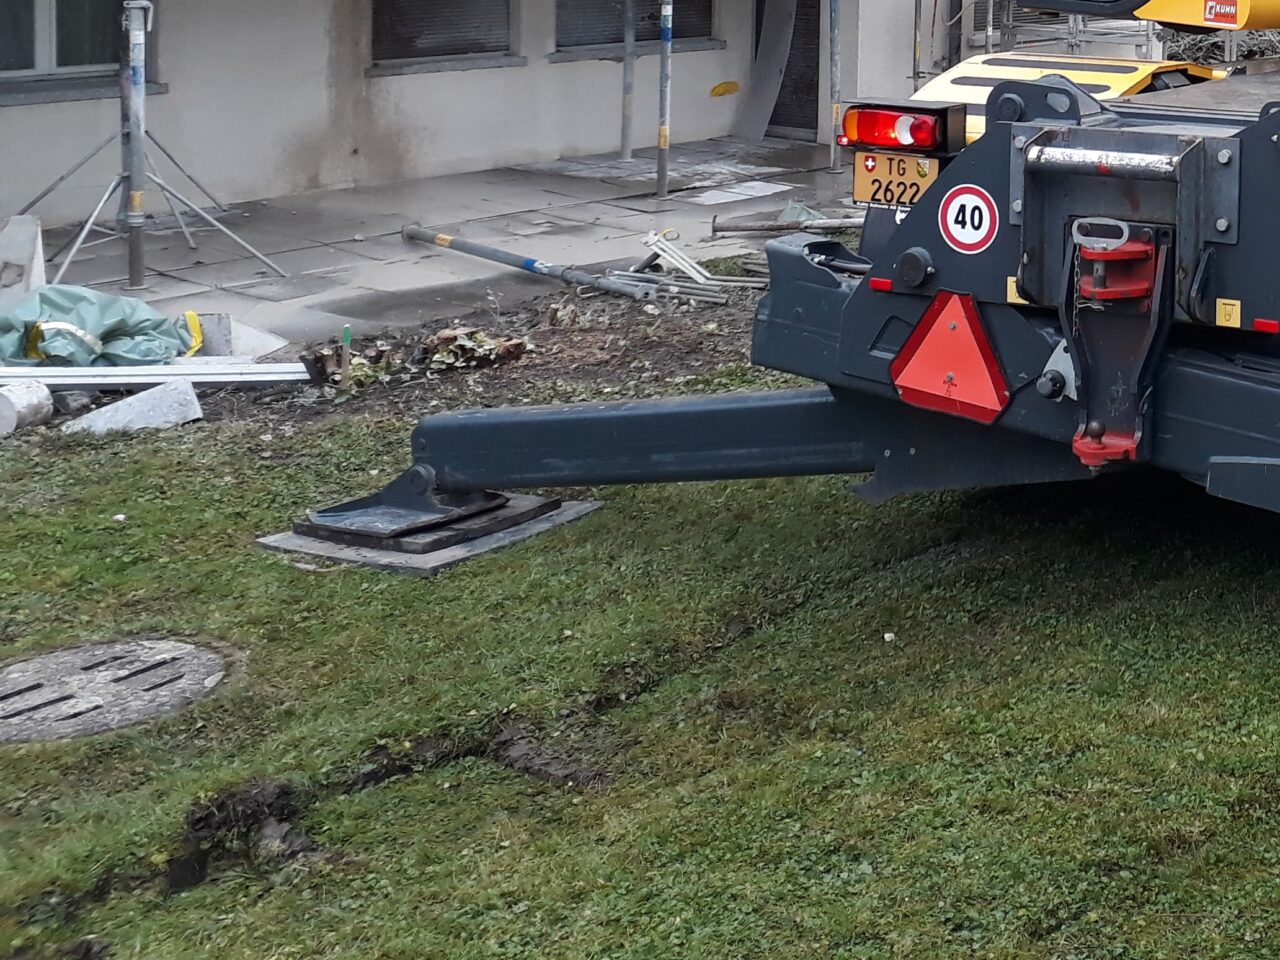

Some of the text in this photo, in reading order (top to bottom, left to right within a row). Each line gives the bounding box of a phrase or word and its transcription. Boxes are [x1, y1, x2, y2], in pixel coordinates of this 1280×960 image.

[886, 157, 906, 176] TG
[870, 178, 921, 206] 2622
[953, 203, 984, 232] 40
